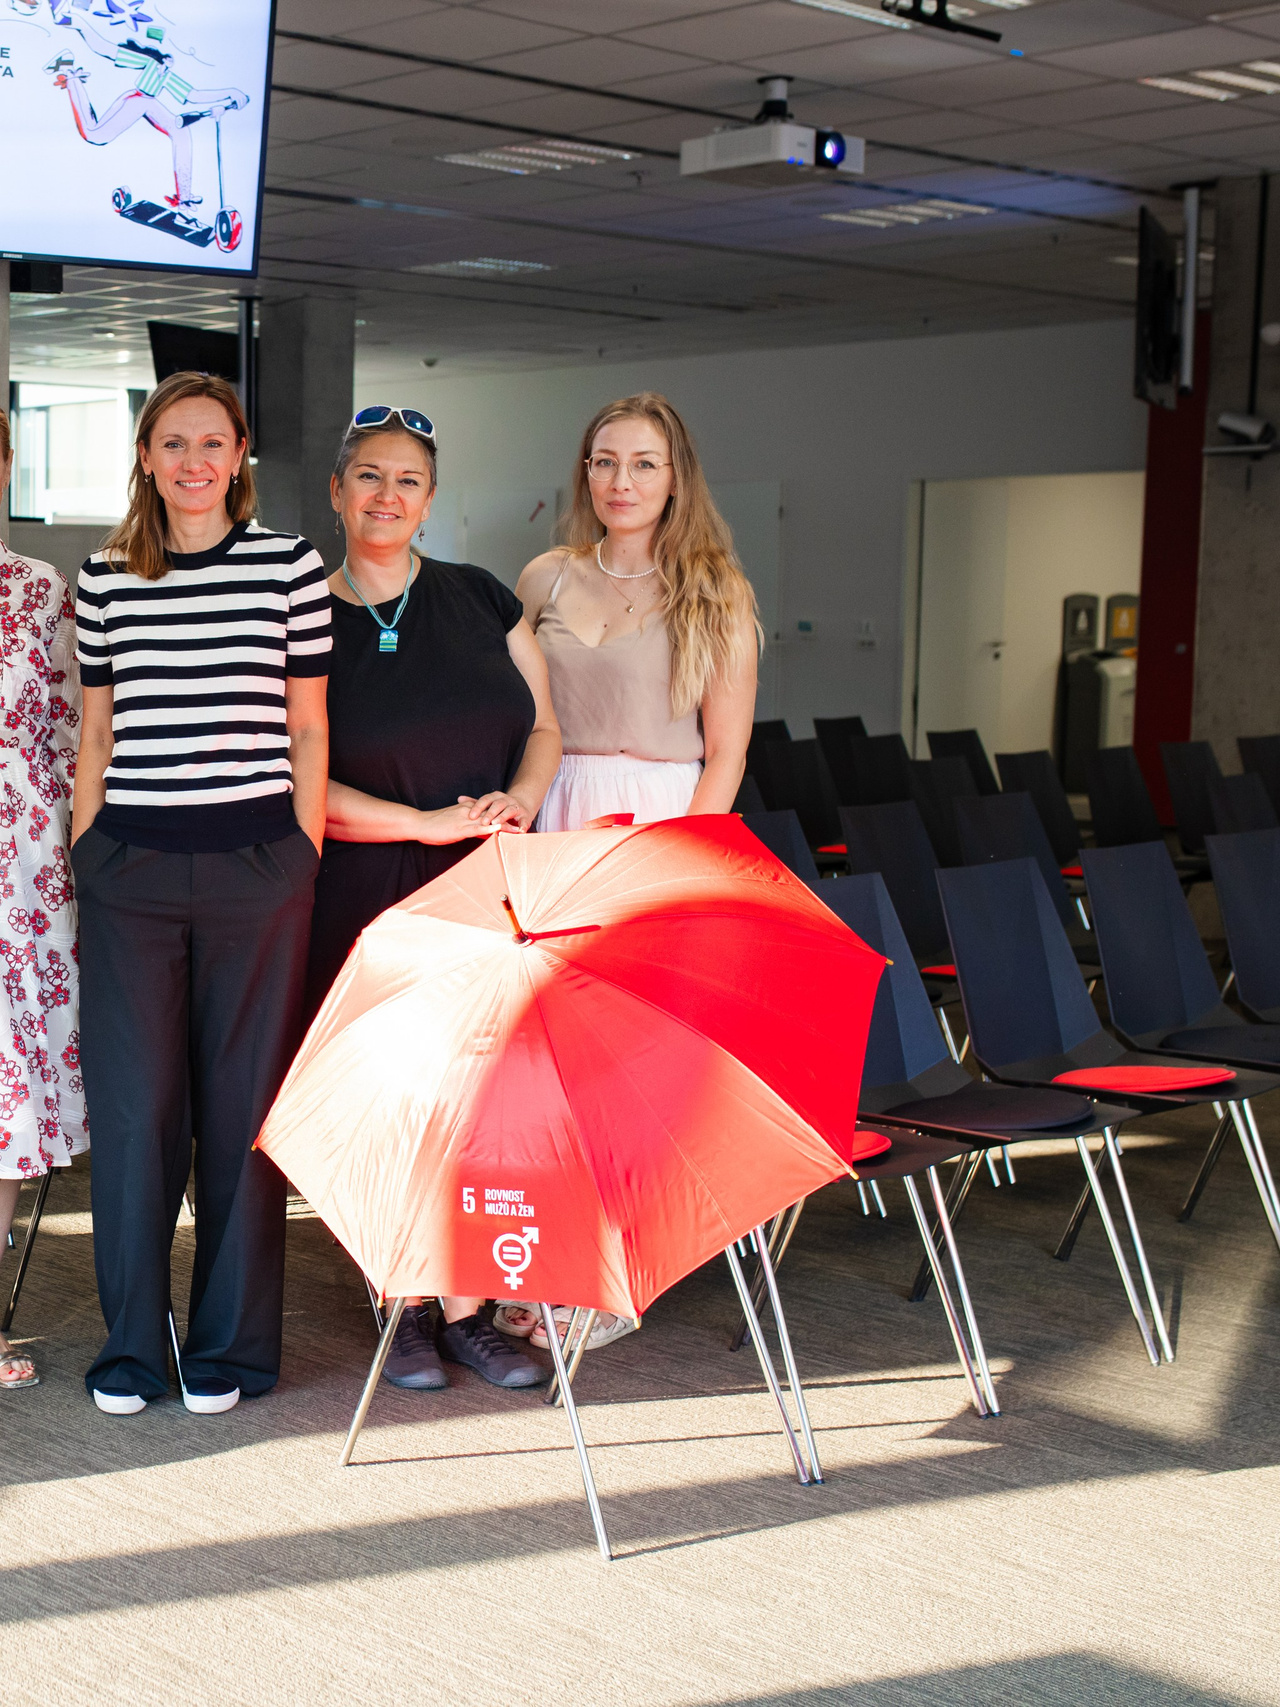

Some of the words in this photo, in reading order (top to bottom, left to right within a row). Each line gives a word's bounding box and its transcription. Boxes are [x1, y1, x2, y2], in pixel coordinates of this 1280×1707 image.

[462, 1187, 476, 1214] 5
[484, 1188, 525, 1203] ROVNOST
[510, 1204, 517, 1216] A
[517, 1203, 535, 1218] ŽEN
